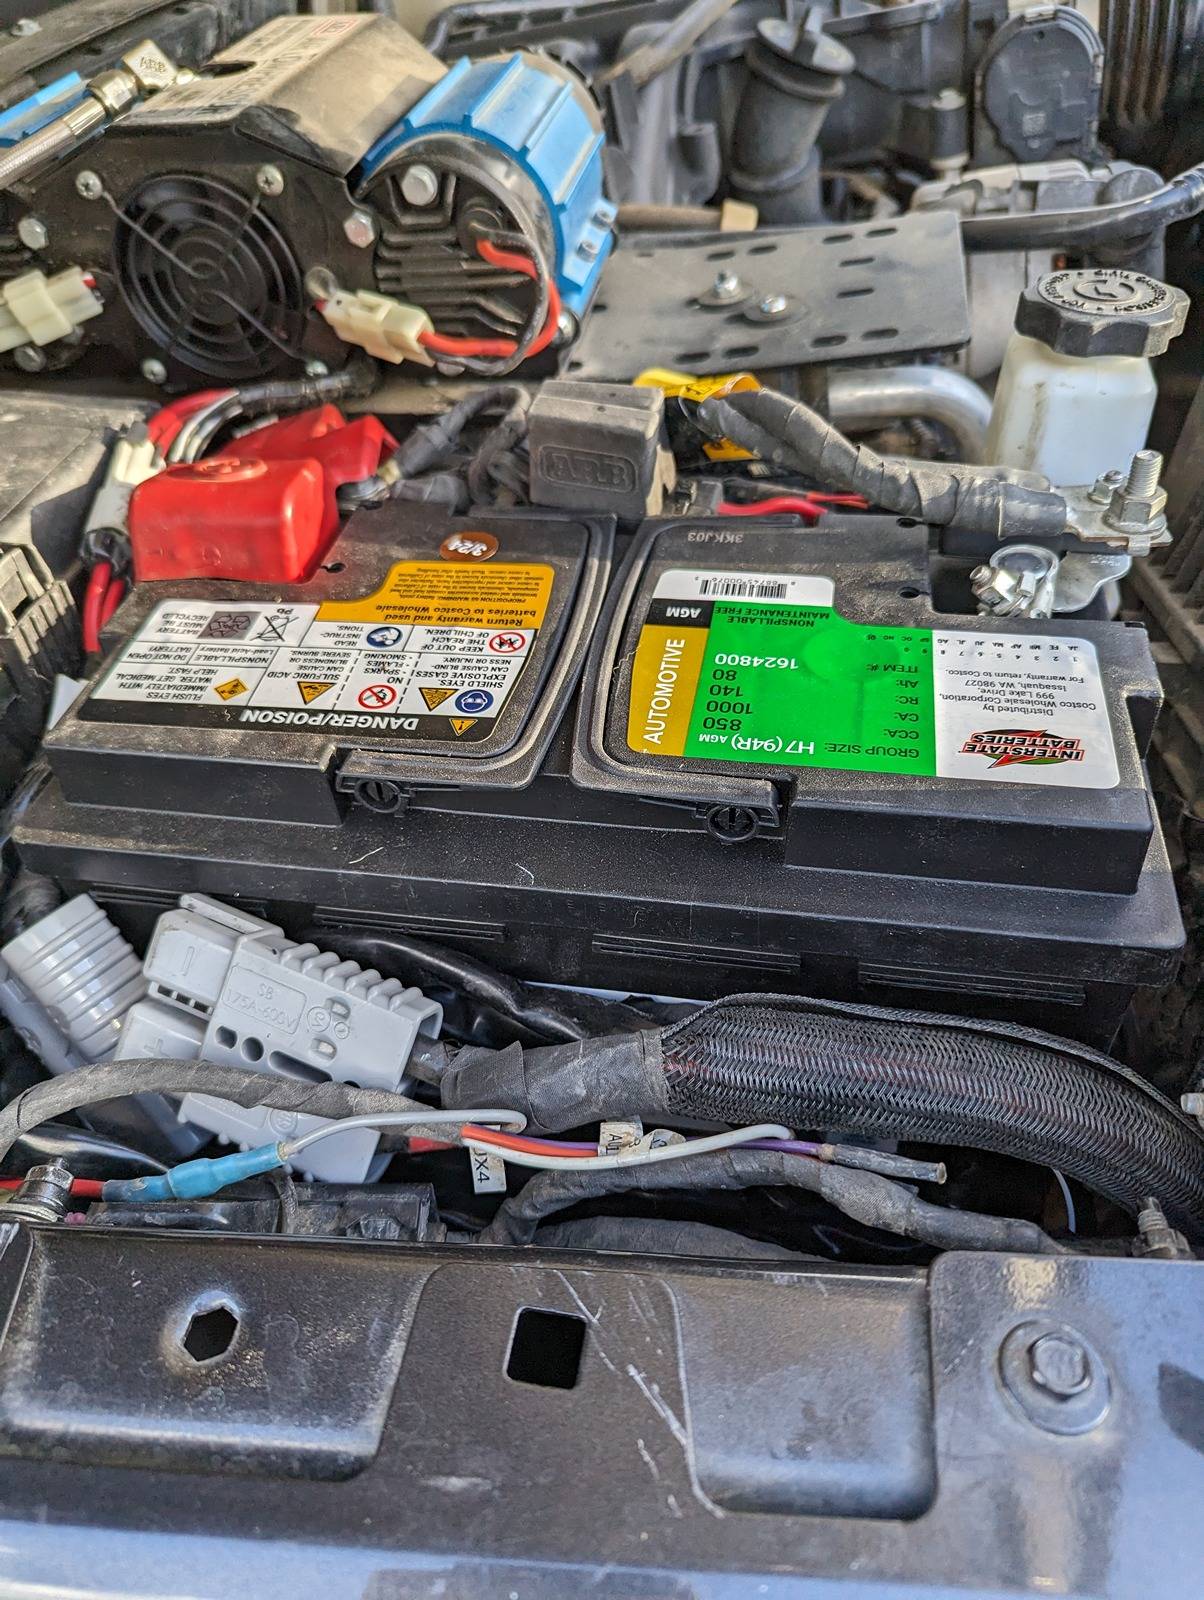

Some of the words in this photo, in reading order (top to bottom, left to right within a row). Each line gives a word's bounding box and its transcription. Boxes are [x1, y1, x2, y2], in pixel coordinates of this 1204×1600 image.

[376, 605, 430, 613] Wholesale
[665, 606, 701, 619] AGM
[745, 608, 830, 619] MAINTENANCE
[436, 615, 483, 624] warranty
[727, 616, 814, 627] NONSPILLABLE
[193, 654, 269, 664] NONSPILLABLE
[714, 653, 799, 669] 1624800
[193, 668, 218, 676] HELP
[883, 664, 918, 673] ITEM
[115, 673, 155, 682] MEDICAL
[293, 672, 340, 680] SULFURIC
[451, 672, 506, 680] EXPLOSIVE
[712, 669, 737, 681] 80
[994, 672, 1022, 680] return
[896, 680, 919, 688] Ah:
[964, 680, 995, 688] 98027
[1068, 676, 1084, 684] For
[118, 682, 143, 690] WITH
[146, 683, 208, 692] IMMEDIATELY
[998, 681, 1015, 689] WA
[642, 638, 686, 745] AUTOMOTIVE
[709, 684, 743, 697] 140
[1009, 690, 1032, 698] Lake
[146, 692, 170, 700] EYES
[171, 692, 203, 701] FLUSH
[895, 696, 918, 705] RC:
[706, 700, 753, 714] 1000
[1004, 698, 1056, 708] Wholesale
[1059, 701, 1096, 710] Costco
[982, 704, 994, 712] by
[997, 706, 1053, 716] Distributed
[239, 709, 419, 730] DANGER/POISON
[894, 712, 919, 722] CA:
[703, 717, 742, 731] 850
[698, 734, 728, 743] AGM
[883, 729, 919, 739] CCA:
[731, 733, 783, 753] (94R)
[972, 734, 1076, 748] BATTERIES
[785, 740, 815, 754] H7
[824, 742, 862, 754] SIZE:
[865, 746, 919, 758] GROUP
[964, 744, 1081, 760] INTERSTATE
